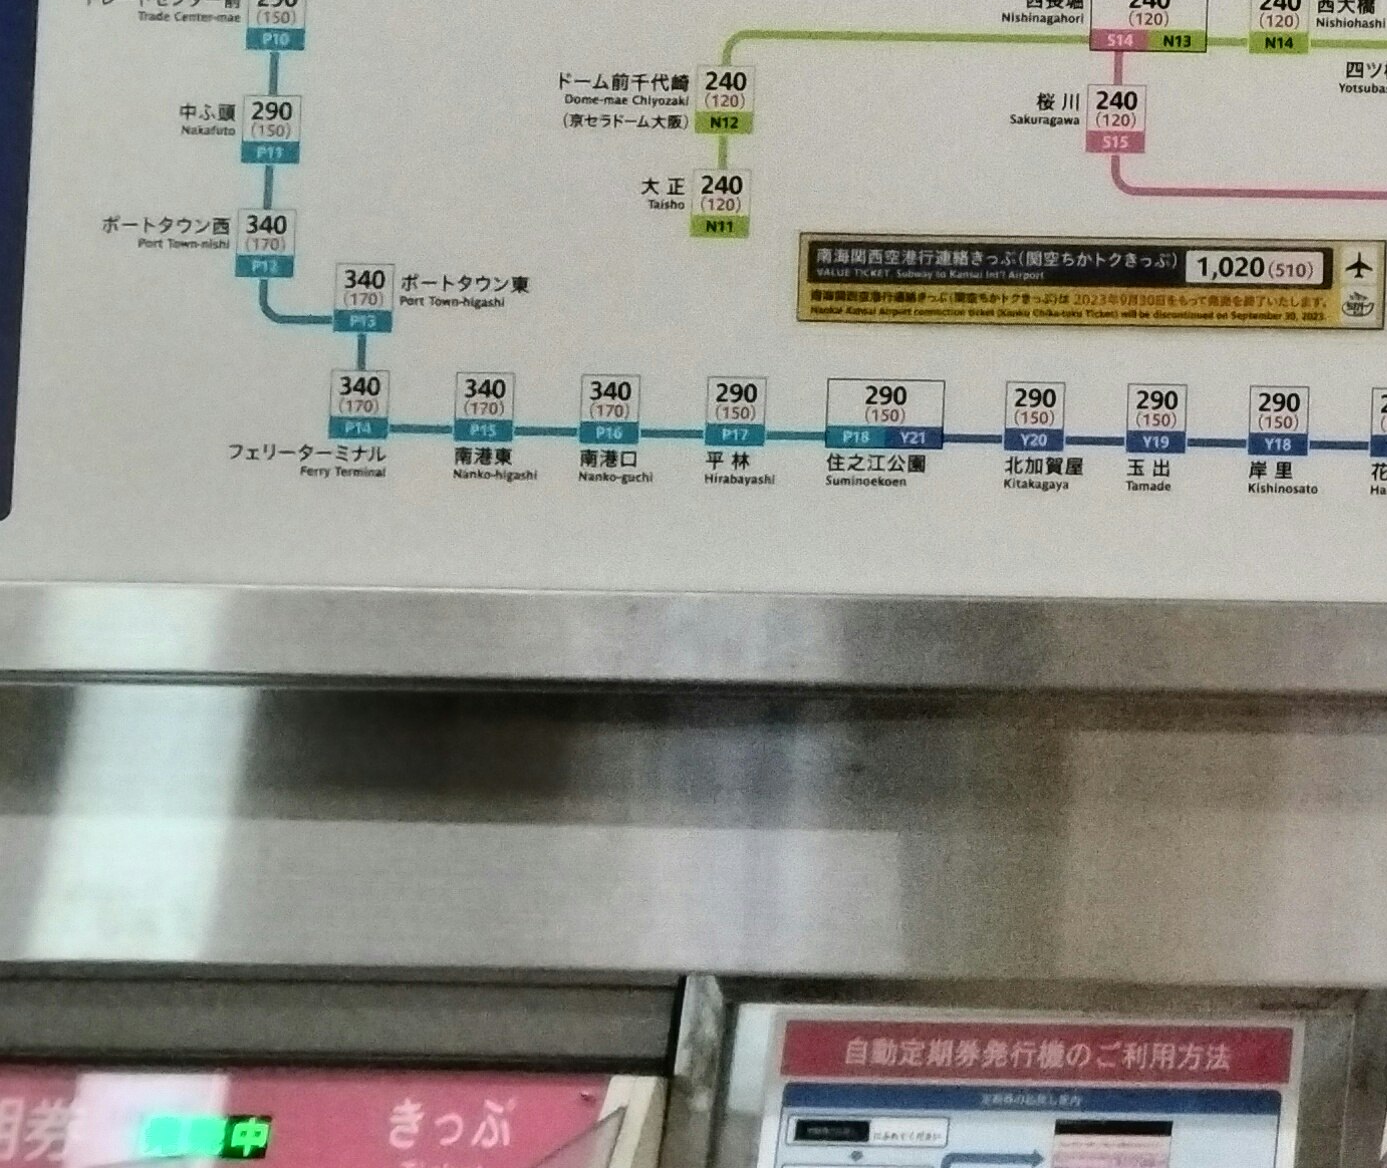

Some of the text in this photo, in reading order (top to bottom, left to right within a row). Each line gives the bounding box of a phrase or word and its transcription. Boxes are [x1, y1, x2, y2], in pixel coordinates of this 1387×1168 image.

[402, 274, 528, 293] ポートタウン東
[229, 444, 386, 462] フェリーターミナル
[827, 453, 925, 473] 住之江公園
[705, 474, 774, 486] Hirabayashi
[845, 1035, 1230, 1075] 自動定期券発行機のご利用方法
